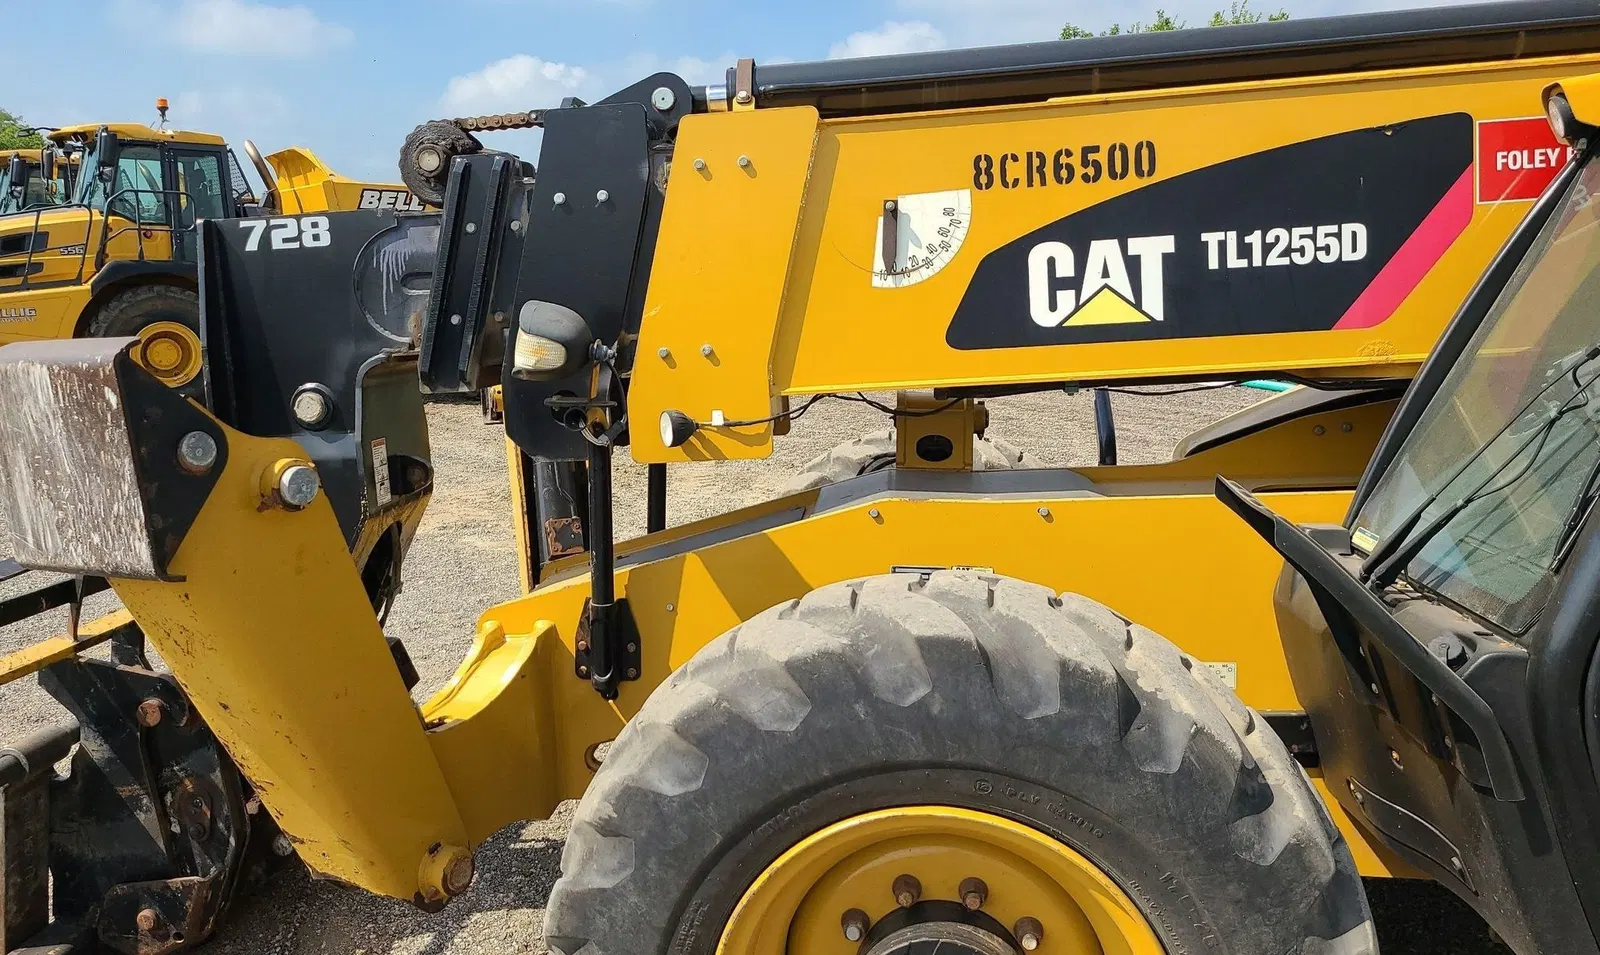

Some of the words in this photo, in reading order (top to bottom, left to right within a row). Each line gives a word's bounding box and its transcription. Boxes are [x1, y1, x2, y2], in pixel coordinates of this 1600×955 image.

[973, 140, 1157, 191] 8CR6500
[1496, 147, 1561, 171] FOLEY
[359, 190, 425, 212] BELL
[943, 207, 956, 217] 80
[949, 219, 962, 229] 70
[239, 215, 332, 252] 728
[938, 226, 951, 238] 60
[926, 243, 938, 256] 40
[939, 240, 952, 252] 50
[1200, 222, 1368, 270] TL1255D
[909, 254, 920, 268] 20
[922, 256, 934, 270] 30
[1028, 234, 1176, 328] CAT
[0, 307, 37, 318] LLIG
